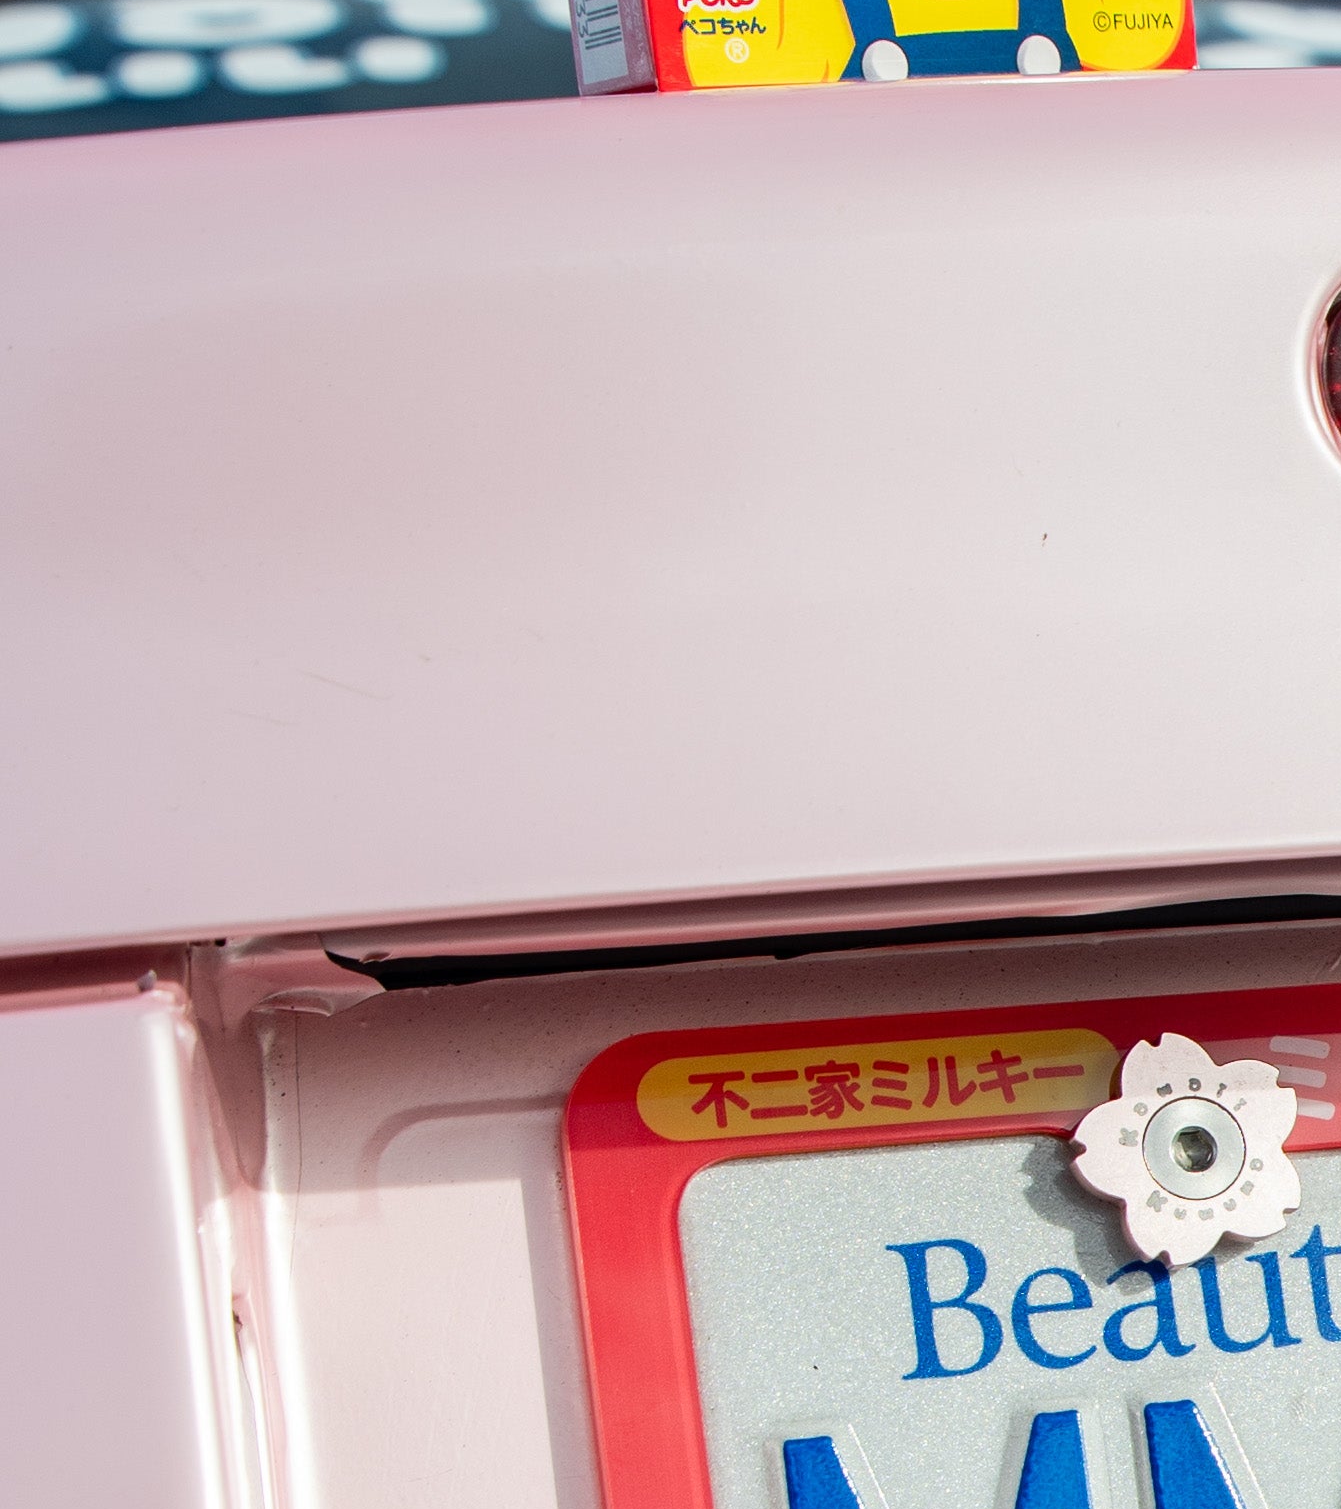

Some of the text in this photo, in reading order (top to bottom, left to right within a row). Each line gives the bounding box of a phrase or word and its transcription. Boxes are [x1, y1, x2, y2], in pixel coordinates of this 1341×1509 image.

[679, 16, 767, 36] ペコちゃん
[687, 1047, 1086, 1129] 不二家ミルキー
